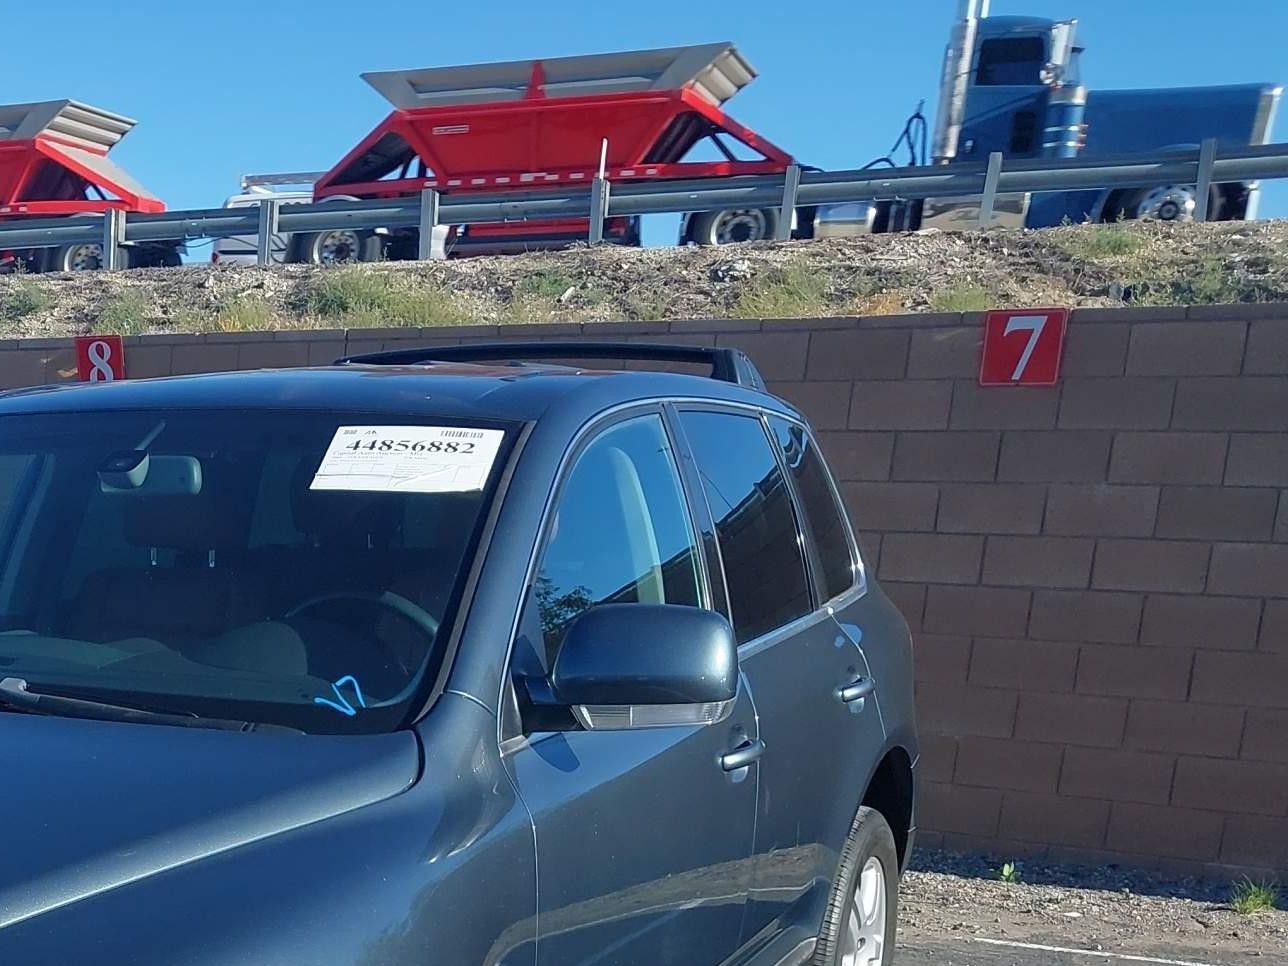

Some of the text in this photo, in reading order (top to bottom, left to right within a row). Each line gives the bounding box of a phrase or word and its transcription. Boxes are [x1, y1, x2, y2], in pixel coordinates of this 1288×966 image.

[88, 341, 114, 383] 8
[1003, 315, 1048, 380] 7
[344, 439, 475, 454] 44856882
